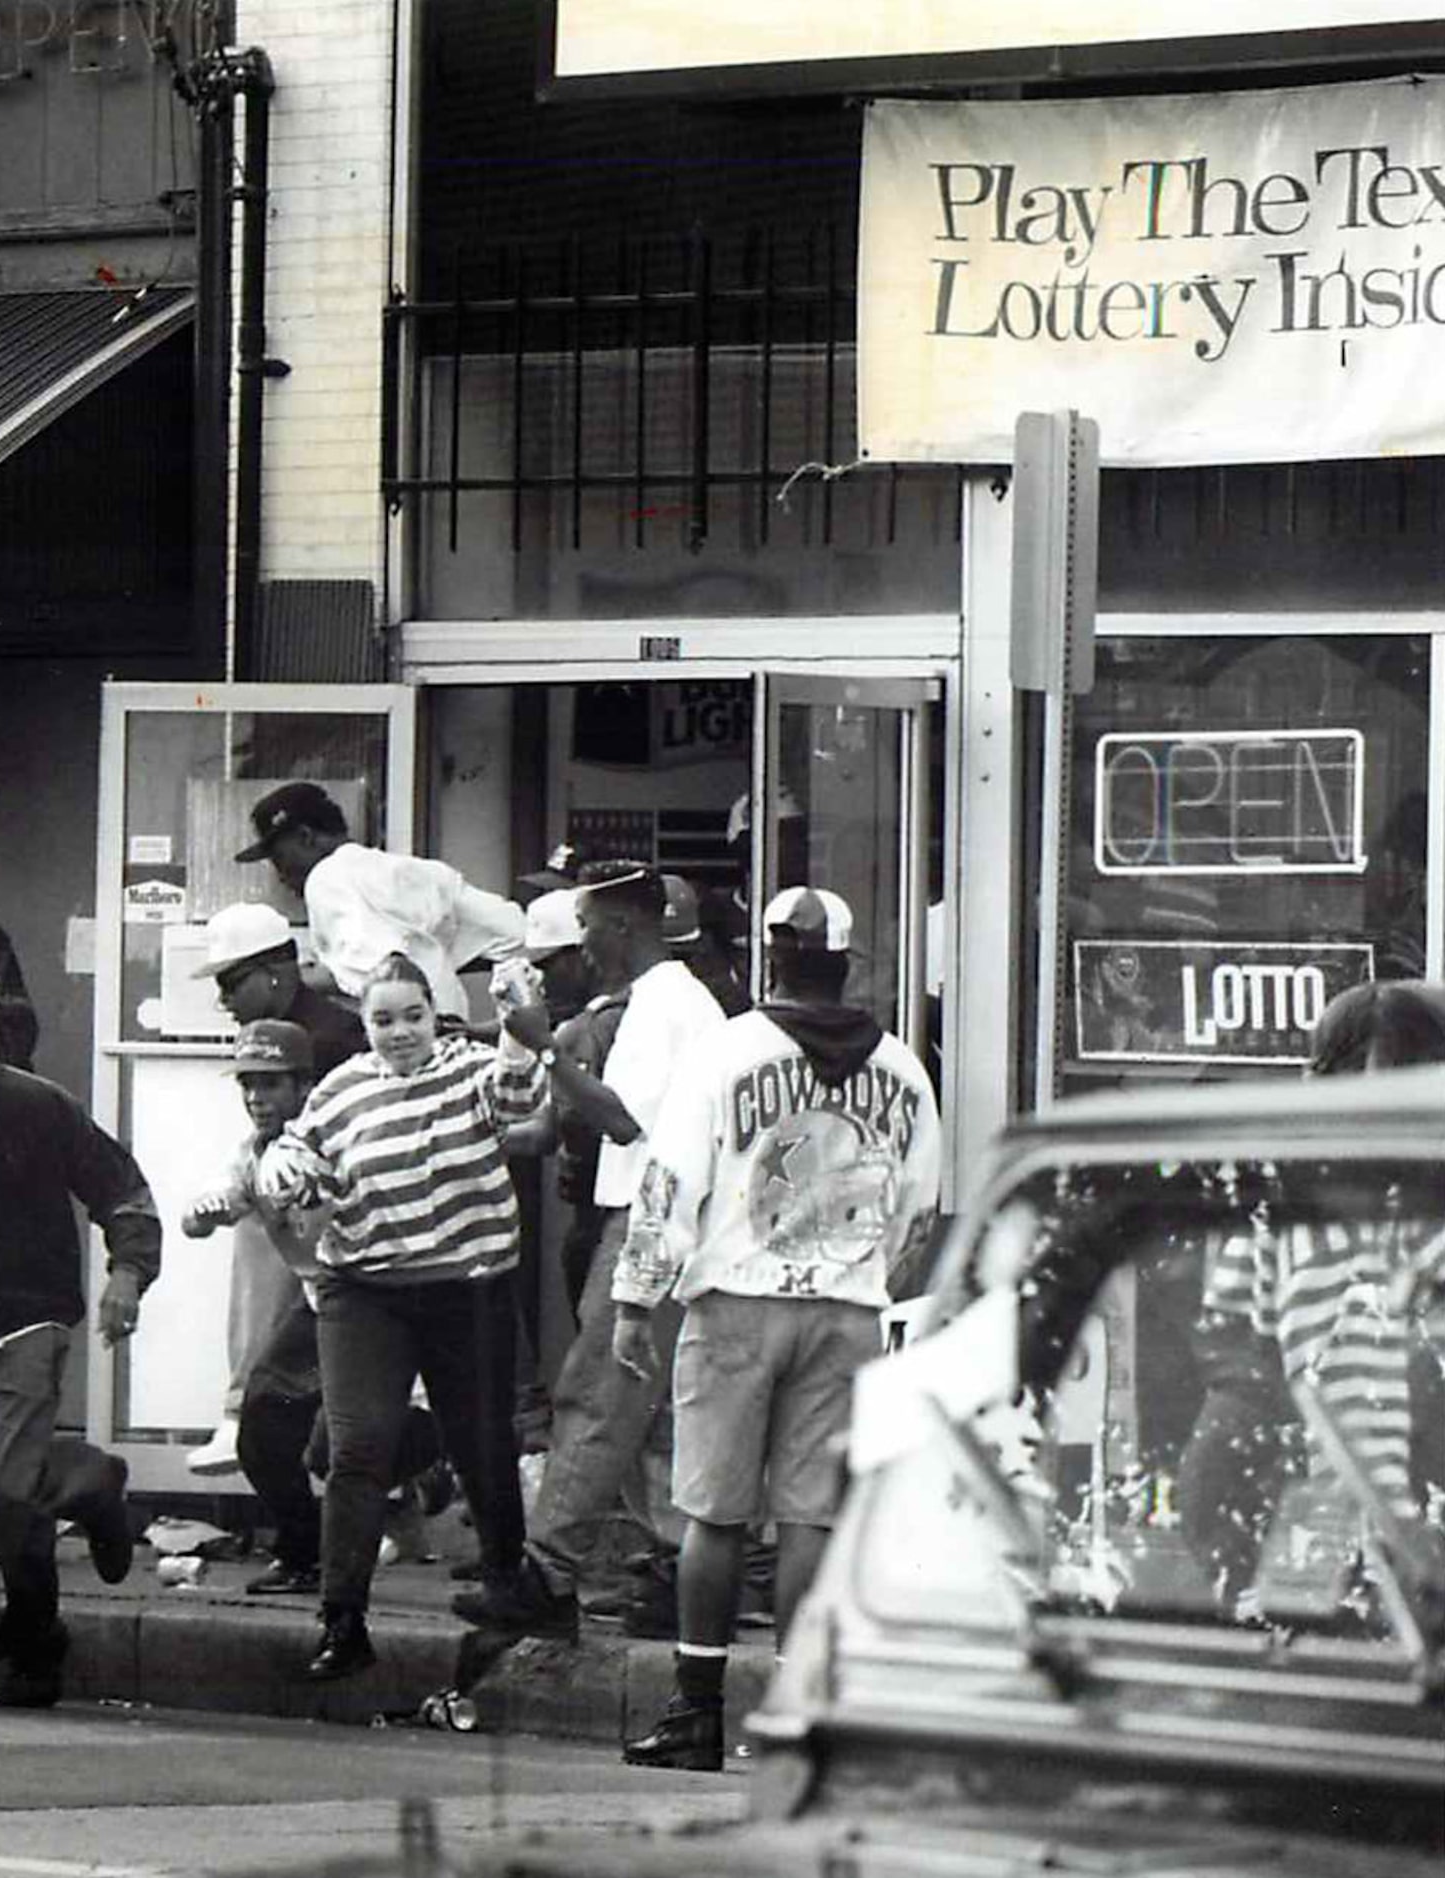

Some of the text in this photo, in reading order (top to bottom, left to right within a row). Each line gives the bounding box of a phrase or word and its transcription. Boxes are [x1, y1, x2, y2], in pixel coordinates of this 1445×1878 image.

[927, 162, 1113, 269] Play
[1122, 156, 1311, 242] The
[924, 257, 1256, 362] Lottery
[1106, 740, 1356, 865] OPEN
[1182, 964, 1325, 1046] LOTTO
